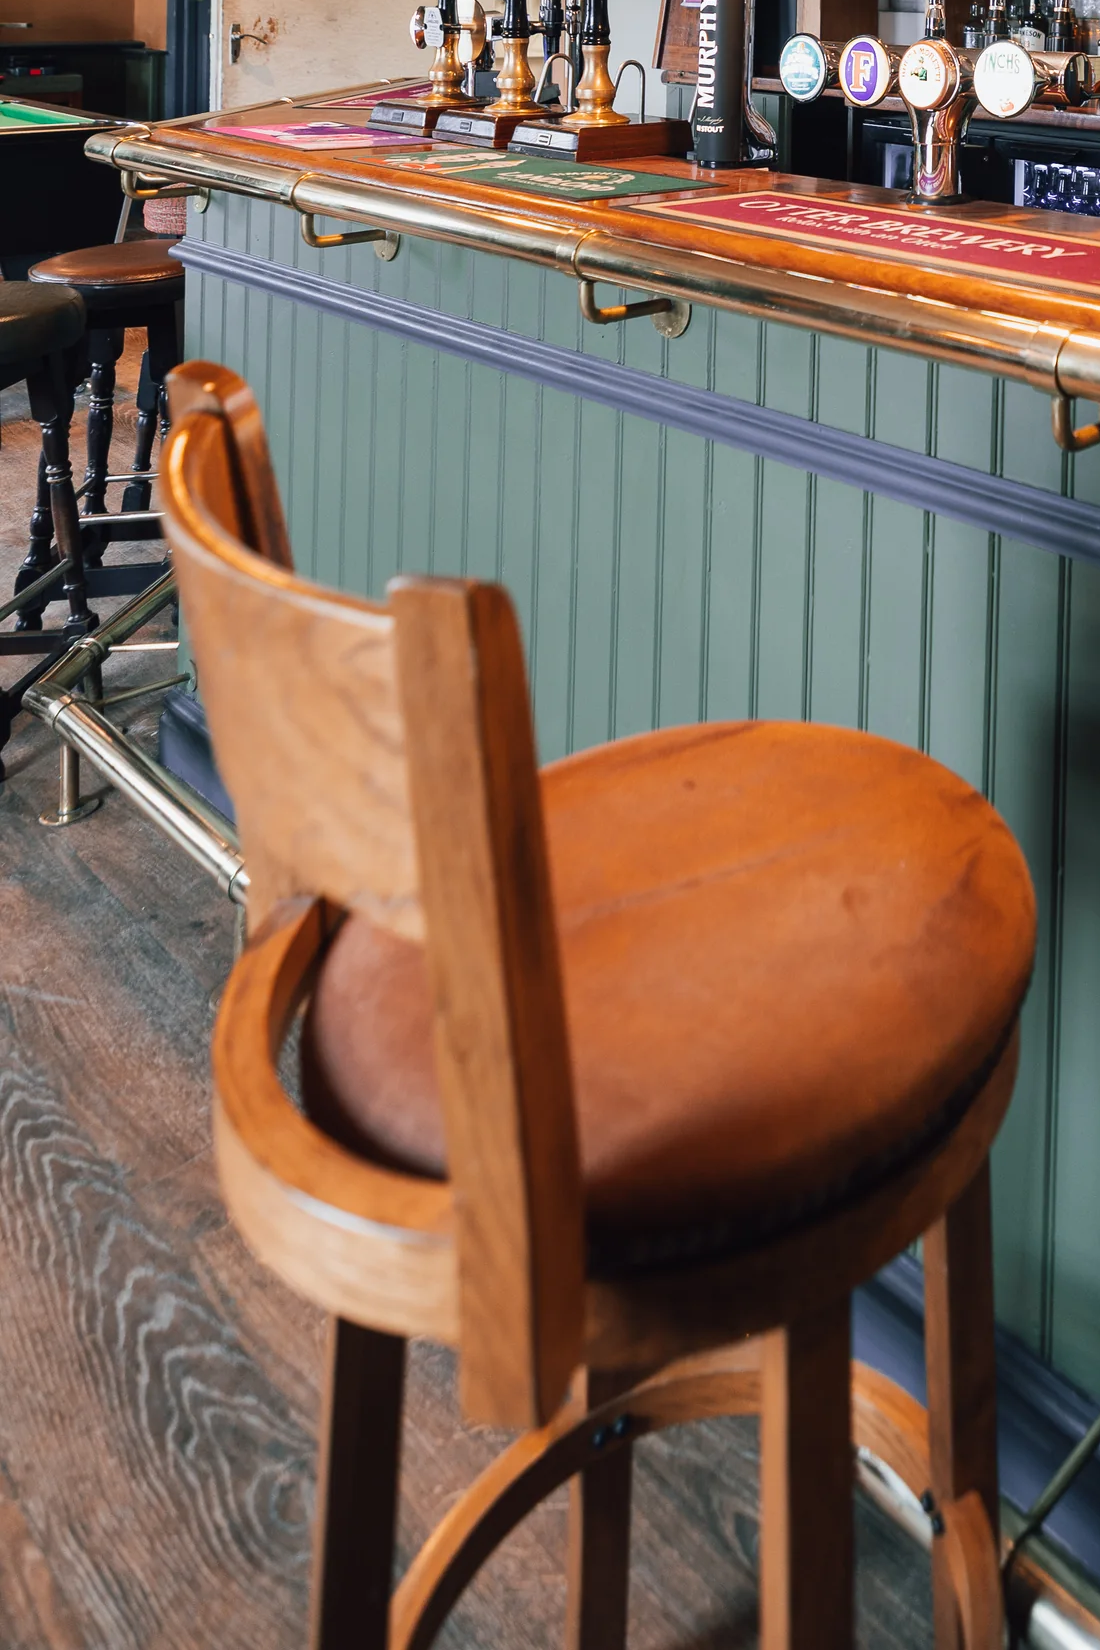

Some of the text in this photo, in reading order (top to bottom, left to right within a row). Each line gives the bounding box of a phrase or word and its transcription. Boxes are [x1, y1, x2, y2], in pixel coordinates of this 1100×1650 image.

[849, 50, 875, 92] F
[983, 51, 1021, 74] INCH'S
[701, 125, 724, 133] STOUT
[738, 200, 1088, 260] OTTER BREWERY
